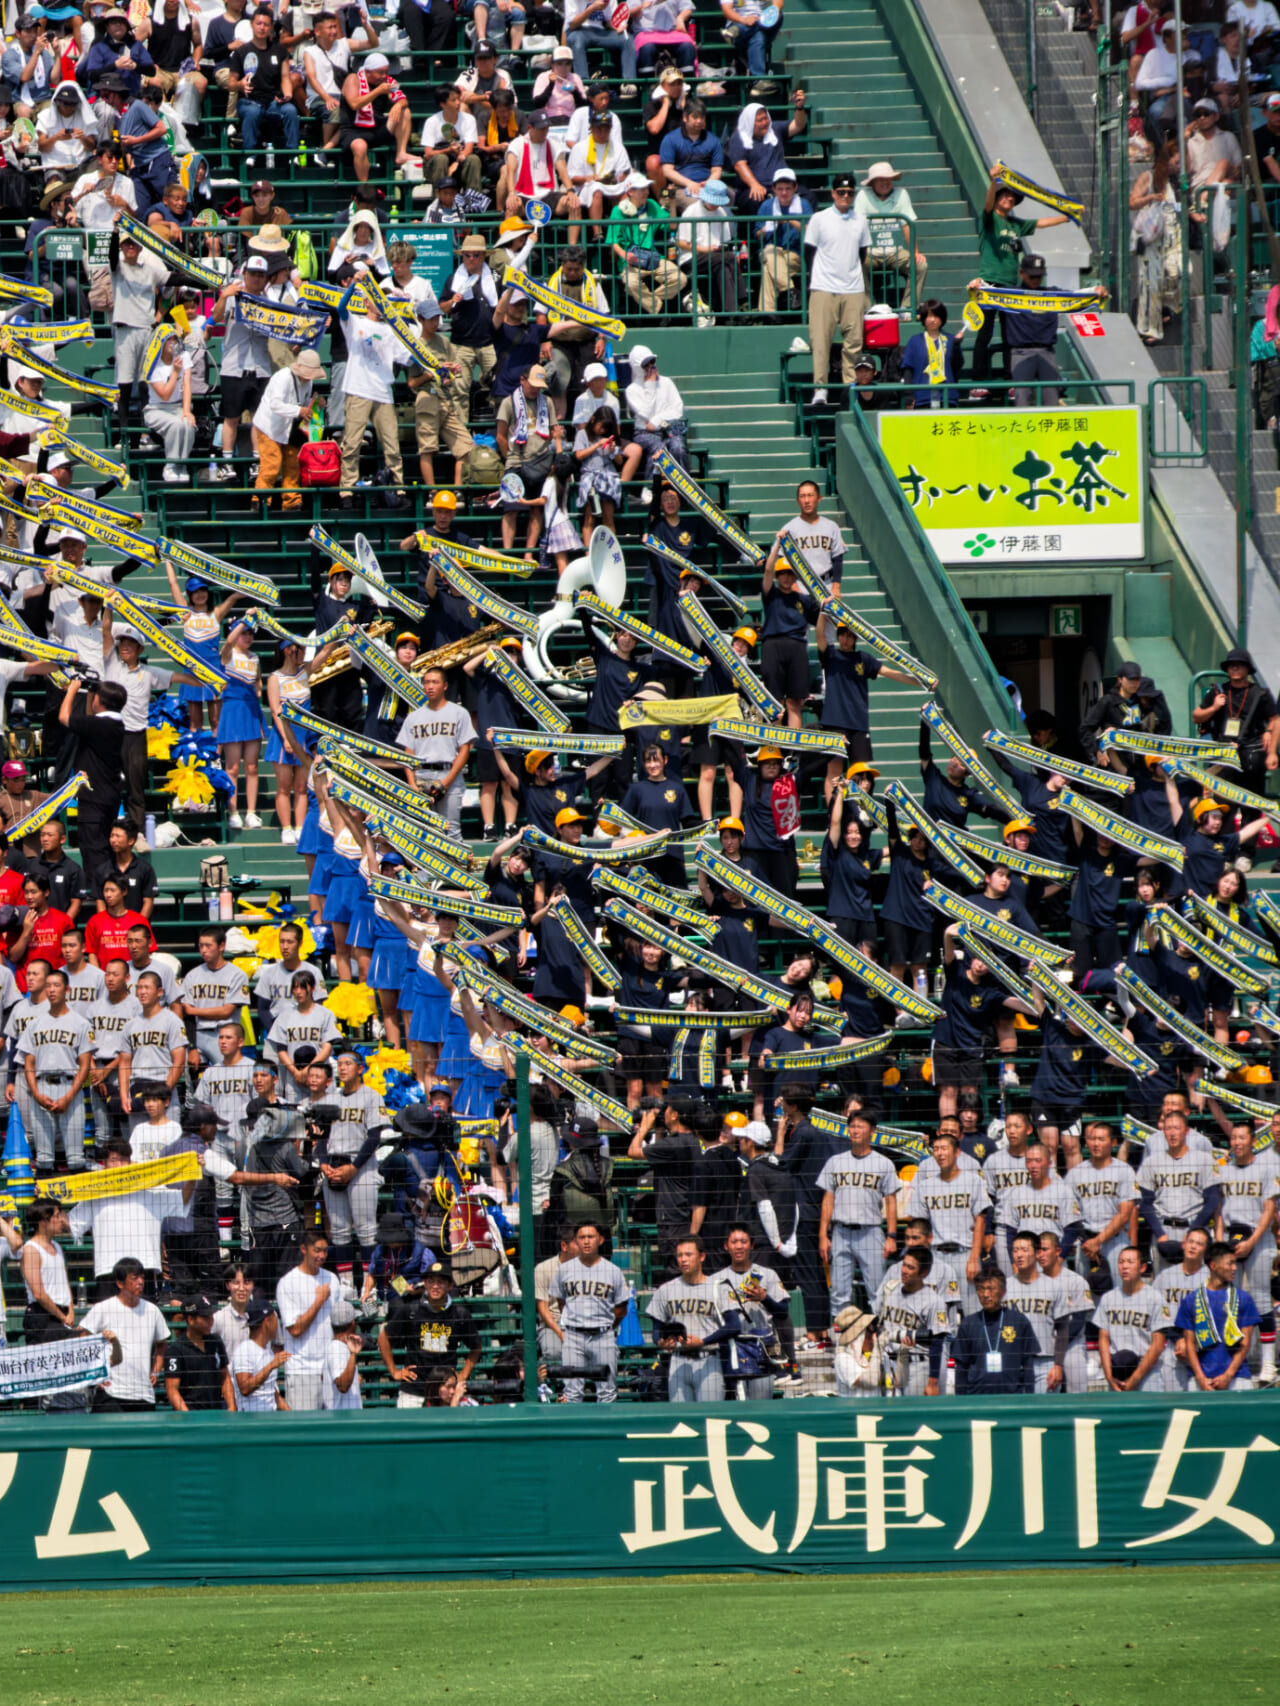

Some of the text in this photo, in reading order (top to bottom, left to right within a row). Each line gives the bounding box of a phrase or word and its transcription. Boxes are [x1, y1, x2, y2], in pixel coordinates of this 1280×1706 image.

[931, 418, 1089, 436] お茶といったら伊藤園
[1000, 534, 1062, 552] 伊藤園
[413, 722, 457, 738] IKUEI
[33, 1031, 79, 1047] IKUEI
[129, 1032, 167, 1048] IKUEI
[208, 1079, 249, 1096] IKUEI
[833, 1170, 880, 1189] IKUEI
[1153, 1172, 1200, 1188] IKUEI
[1077, 1180, 1118, 1197] IKUEI
[925, 1193, 970, 1210] IKUEI
[1017, 1203, 1059, 1220] IKUEI
[563, 1282, 614, 1299] IKUEI
[667, 1299, 714, 1316] IKUEI
[1107, 1309, 1150, 1328] IKUEI
[618, 1408, 1280, 1554] 武庫川女
